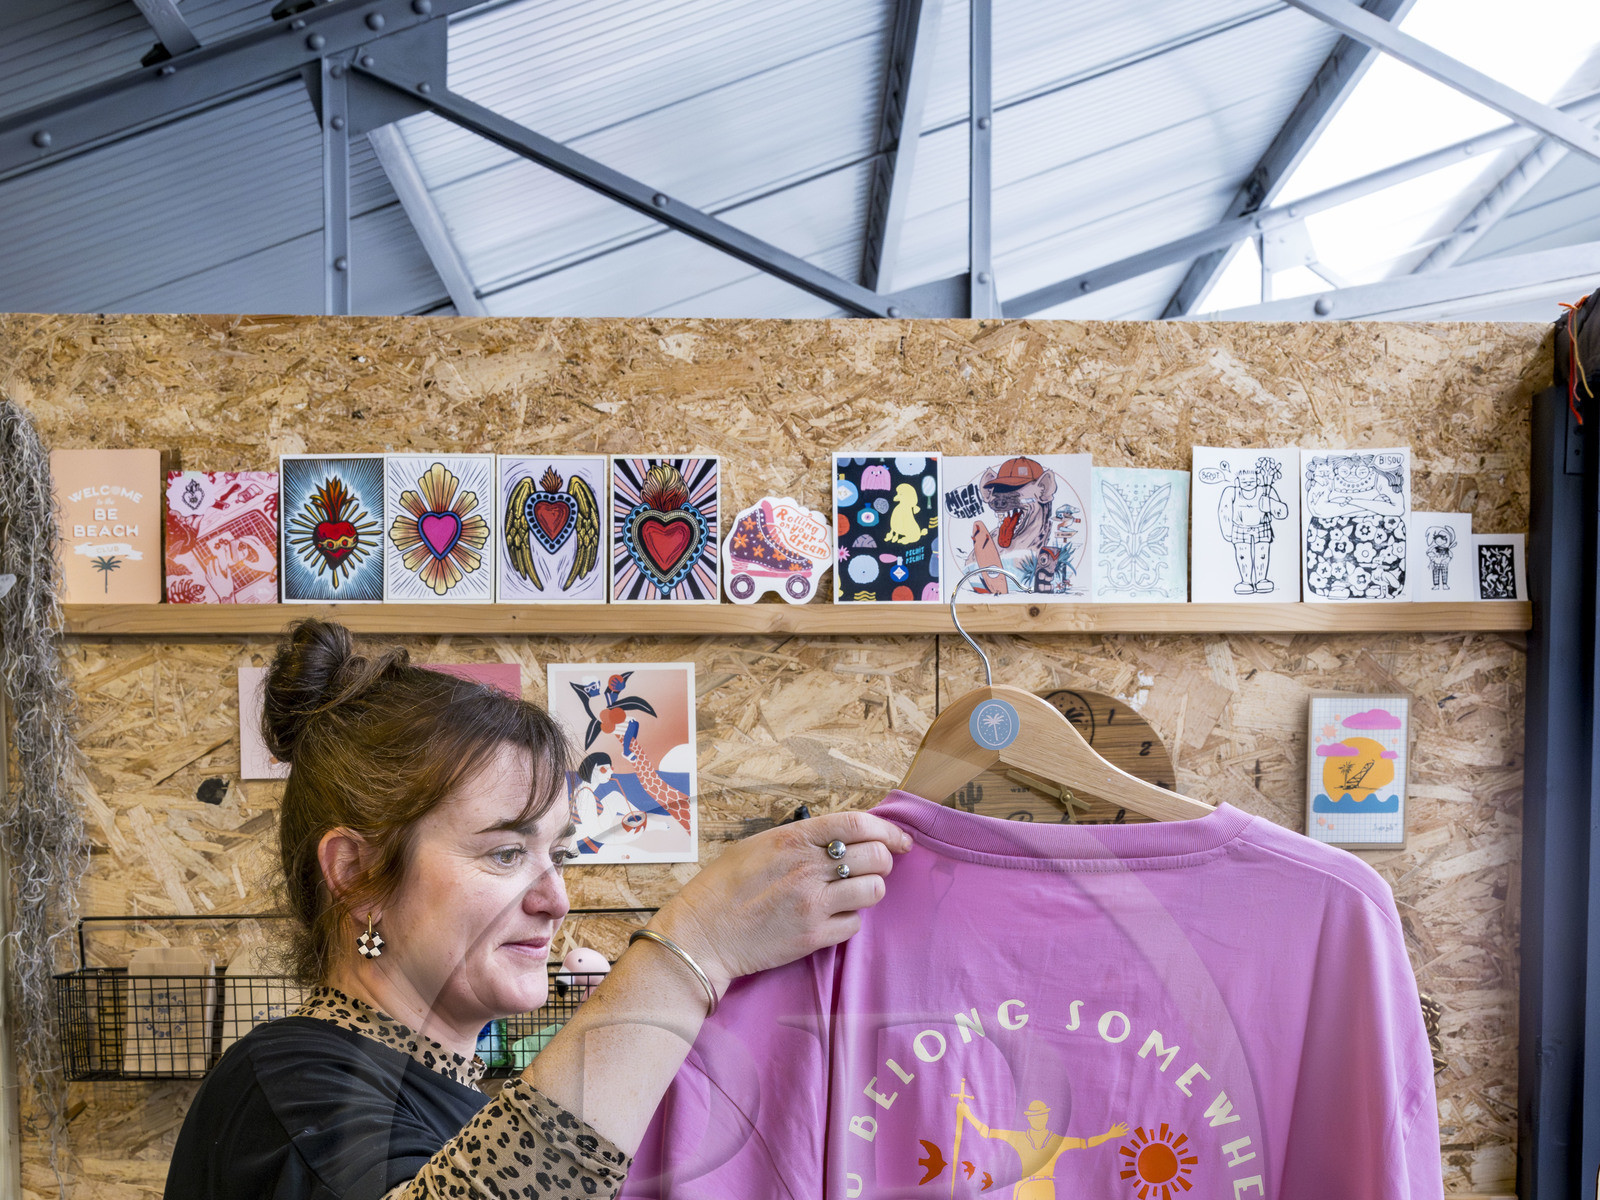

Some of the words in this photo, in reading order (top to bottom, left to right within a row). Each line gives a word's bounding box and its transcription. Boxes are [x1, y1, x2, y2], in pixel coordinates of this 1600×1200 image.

[1379, 455, 1402, 466] BISOU
[67, 485, 143, 504] WELCOME
[93, 508, 119, 521] BE
[776, 508, 820, 536] Rolling
[73, 524, 139, 538] BEACH
[789, 524, 817, 543] your
[789, 533, 828, 558] dream
[1107, 708, 1116, 725] 1
[1138, 741, 1153, 757] 2
[848, 998, 1030, 1143] BELONG
